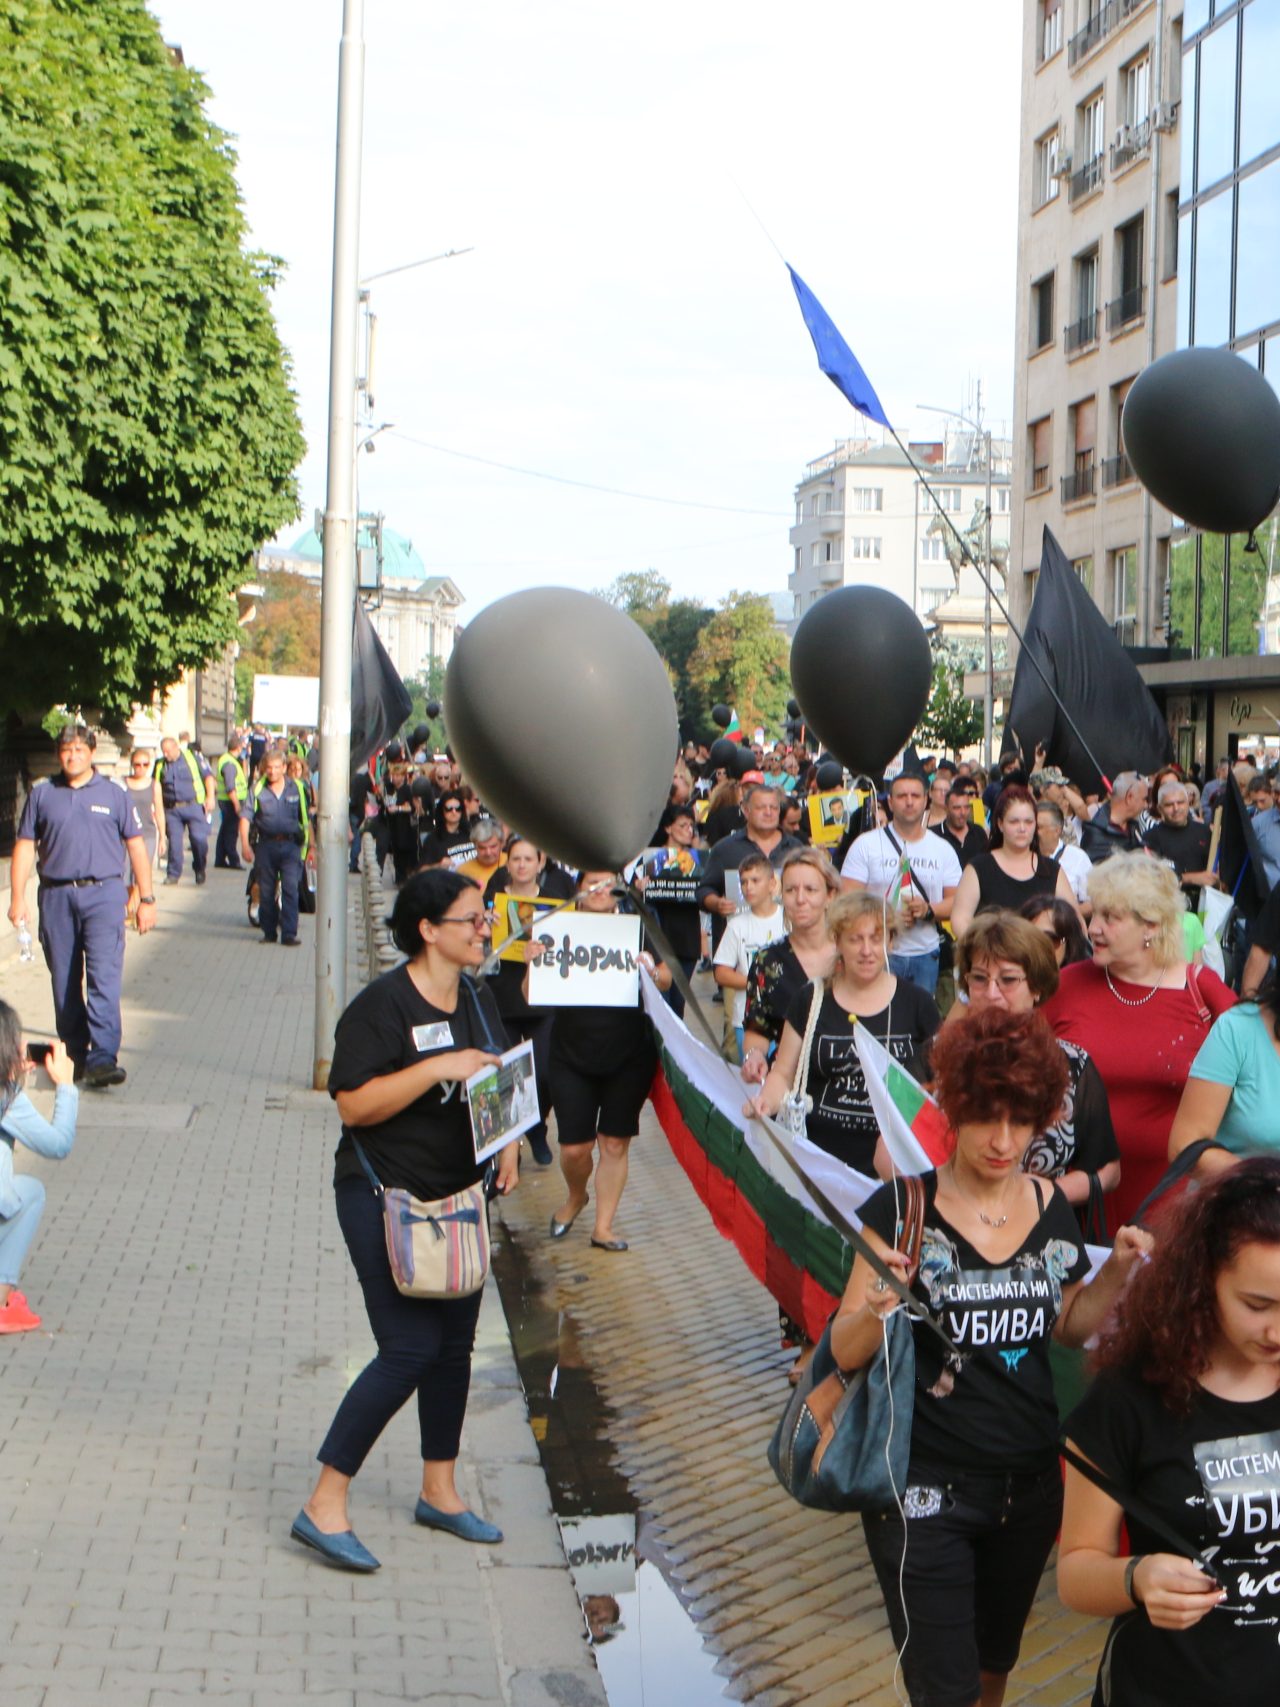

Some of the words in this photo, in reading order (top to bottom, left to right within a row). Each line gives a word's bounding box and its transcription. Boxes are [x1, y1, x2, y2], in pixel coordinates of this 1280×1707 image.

[949, 1282, 1029, 1300] СИСТЕМАТА
[1031, 1279, 1049, 1298] НИ
[950, 1306, 1046, 1345] УБИВА
